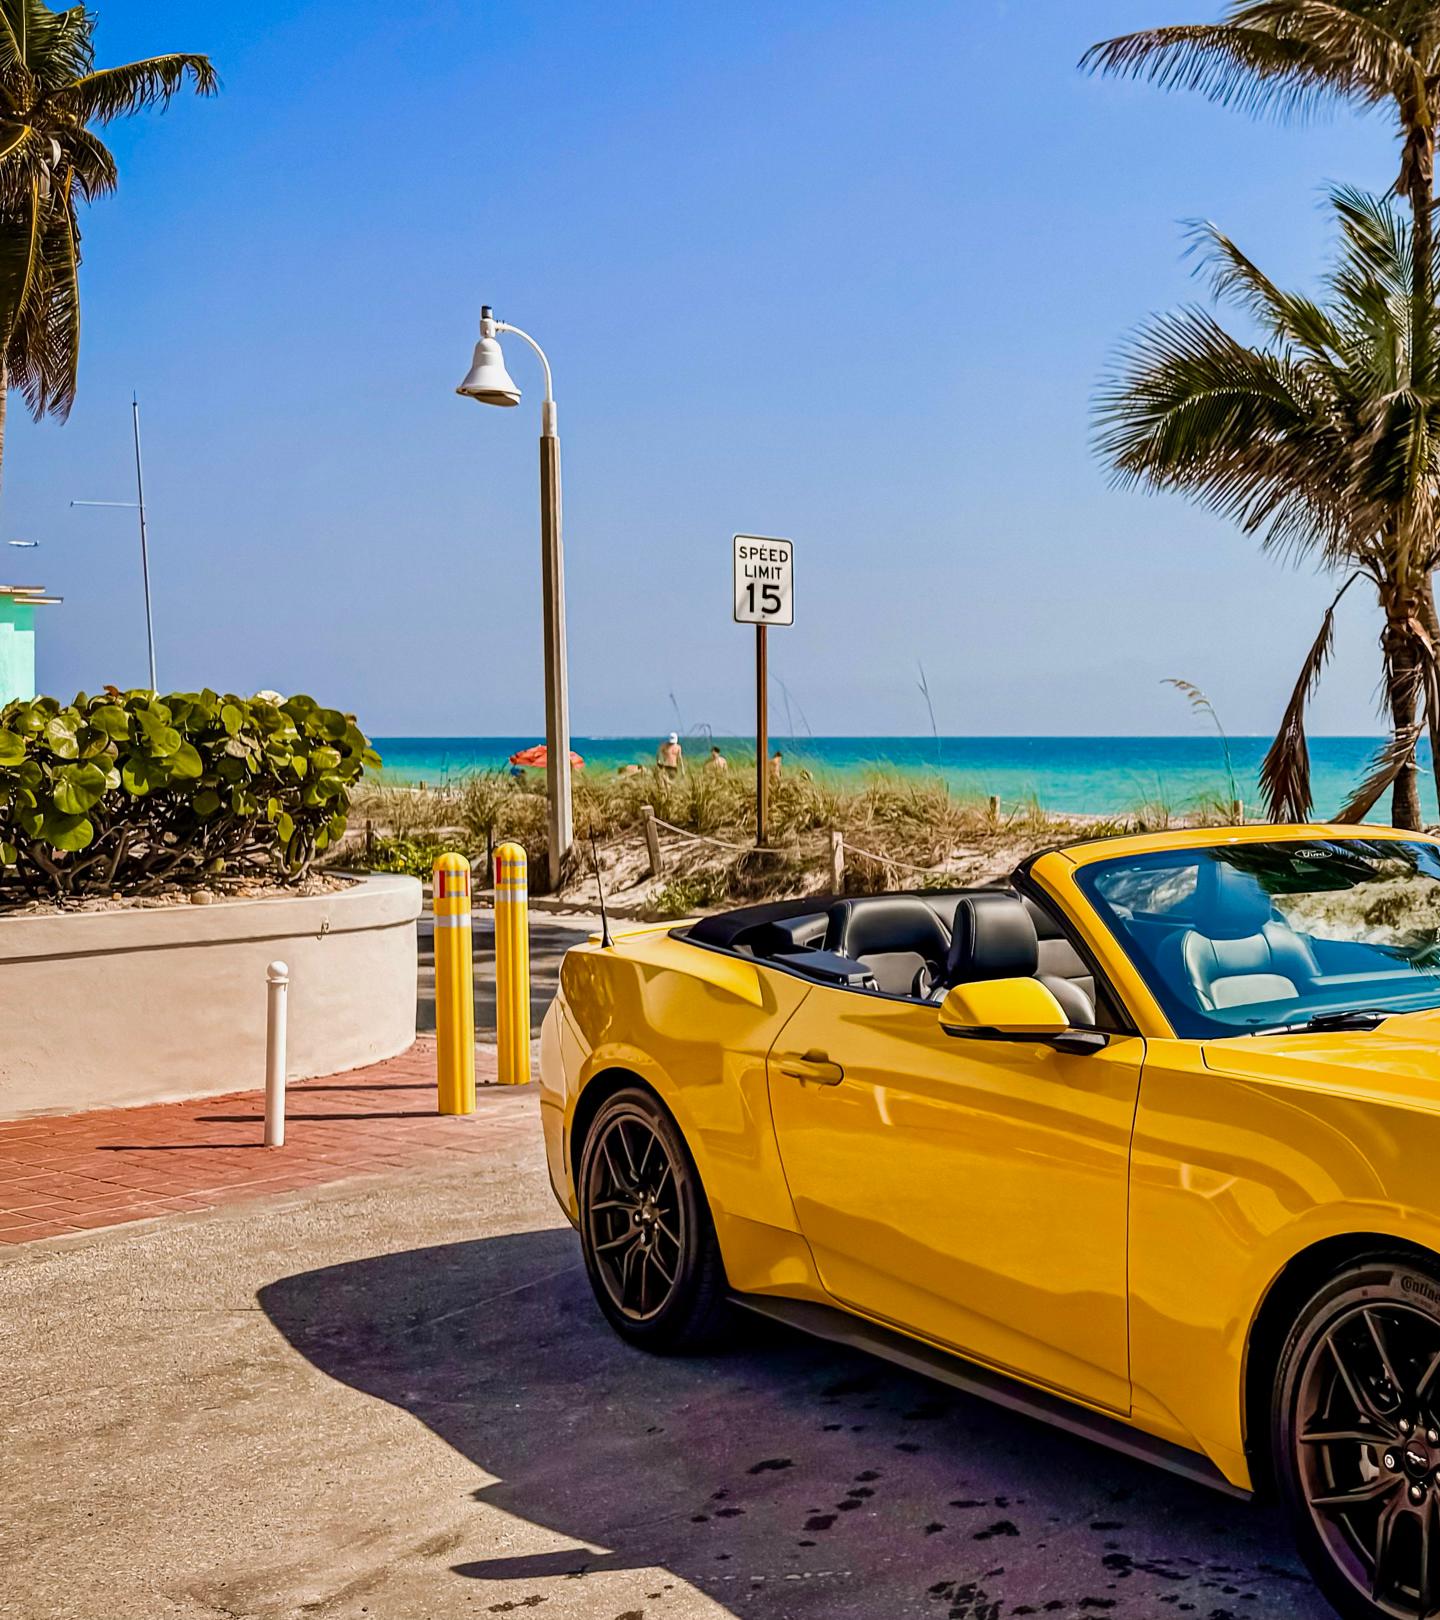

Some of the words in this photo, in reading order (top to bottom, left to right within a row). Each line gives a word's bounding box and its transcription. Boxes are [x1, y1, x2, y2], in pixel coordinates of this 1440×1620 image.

[739, 546, 788, 562] SPEED
[744, 564, 782, 580] LIMIT
[746, 582, 782, 614] 15
